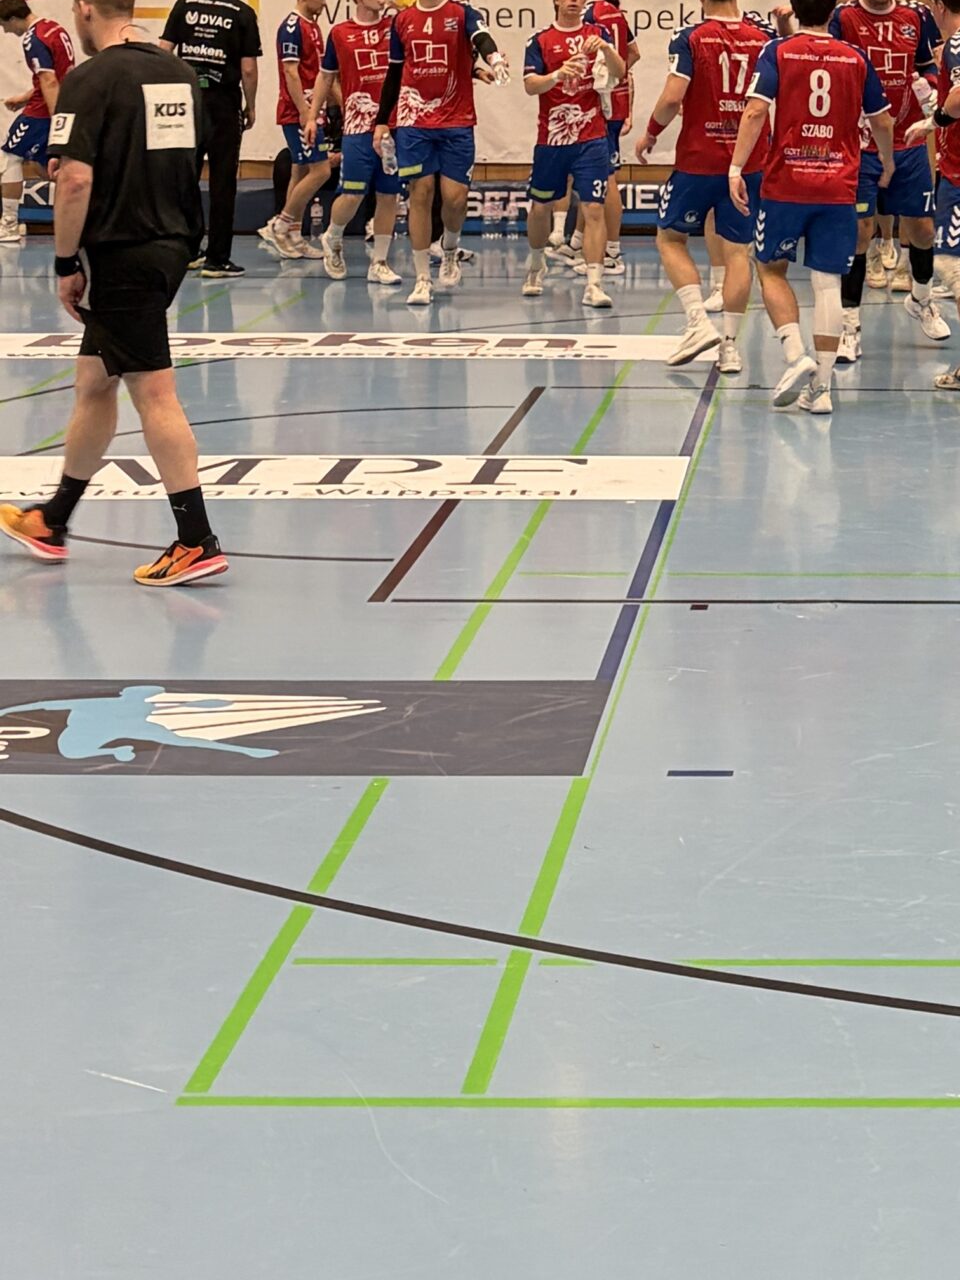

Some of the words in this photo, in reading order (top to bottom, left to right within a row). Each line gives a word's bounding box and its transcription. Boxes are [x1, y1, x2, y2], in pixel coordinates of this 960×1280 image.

[199, 14, 233, 29] DVAG
[422, 17, 433, 35] 4
[362, 29, 379, 45] 19
[59, 32, 73, 61] 6
[719, 51, 749, 94] 17
[808, 68, 831, 118] 8
[801, 124, 834, 139] SZABO
[315, 488, 579, 497] Wuppertal
